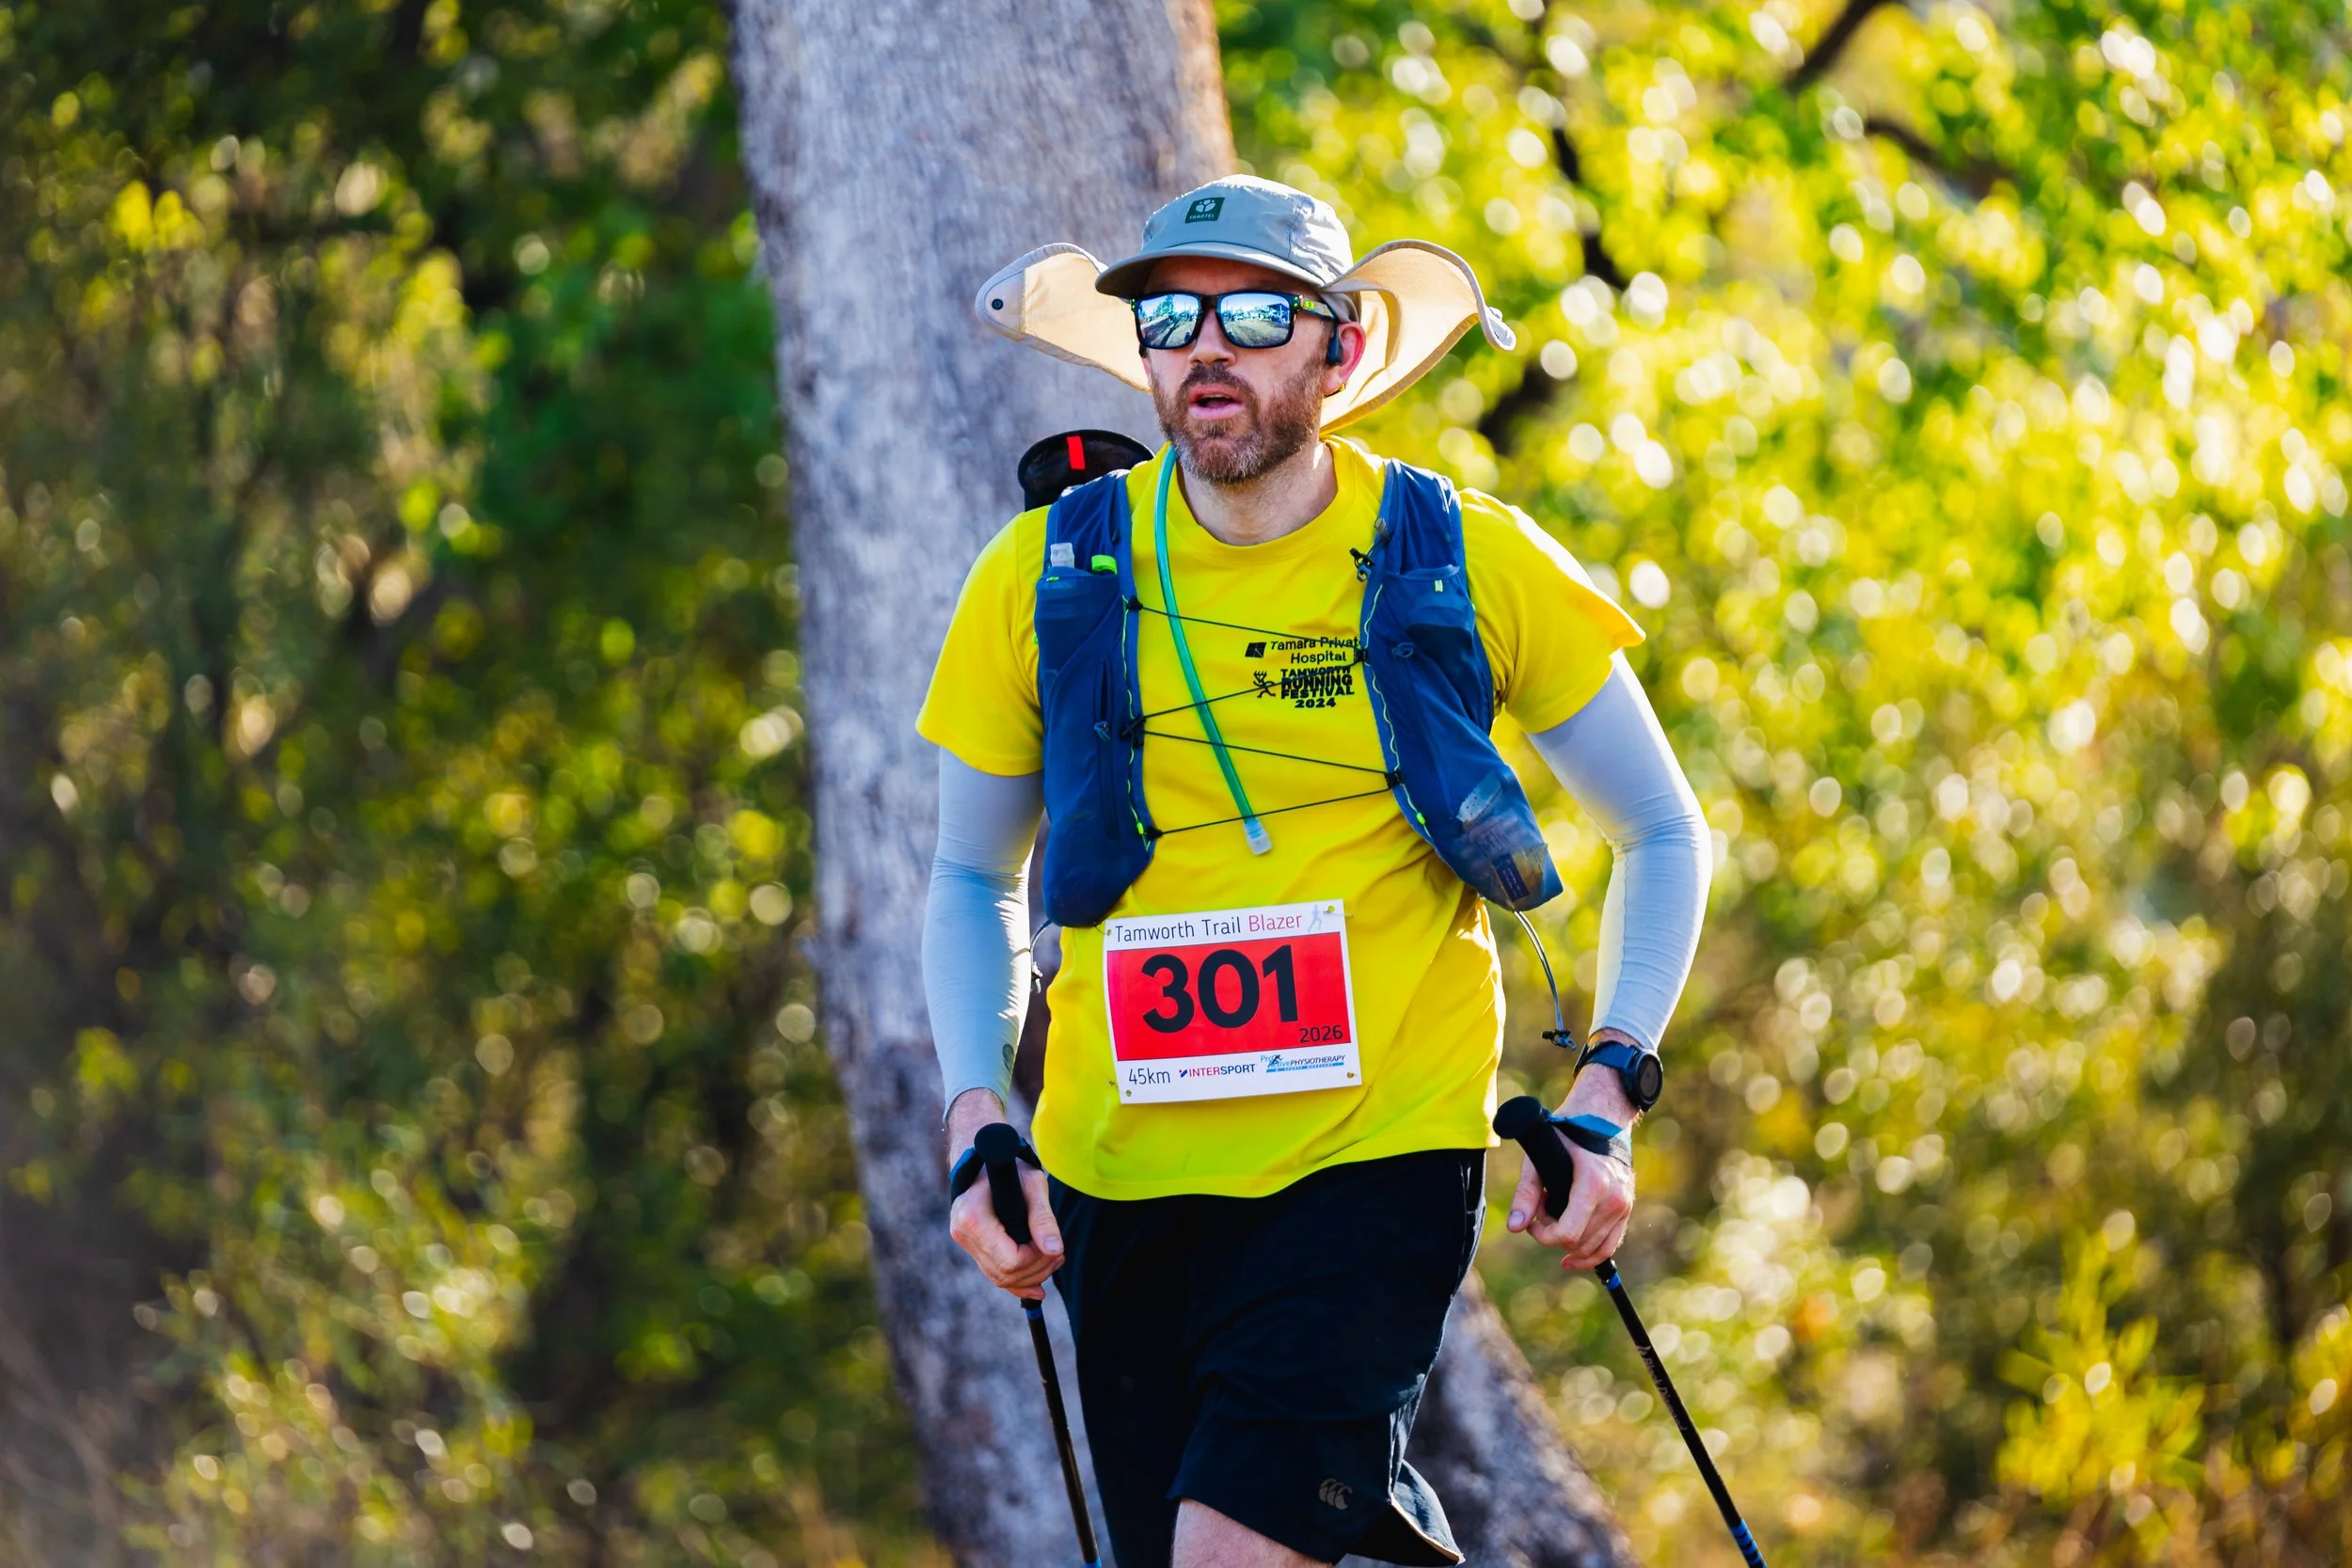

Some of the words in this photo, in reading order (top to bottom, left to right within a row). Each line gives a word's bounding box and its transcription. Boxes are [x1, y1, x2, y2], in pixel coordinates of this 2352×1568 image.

[1270, 640, 1316, 651] Tamara
[1320, 636, 1360, 649] Privat
[1291, 651, 1346, 664] Hospital
[1281, 674, 1353, 689] RUNNING
[1281, 686, 1355, 699] FESTIVAL
[1295, 697, 1336, 708] 2024
[1116, 921, 1195, 942] Tamworth
[1201, 917, 1241, 937] Trail
[1248, 914, 1302, 932] Blazer
[1141, 944, 1298, 1034] 301
[1299, 1024, 1343, 1043] 2026
[1128, 1068, 1171, 1085] 45km
[1188, 1063, 1256, 1077] INTERSPORT
